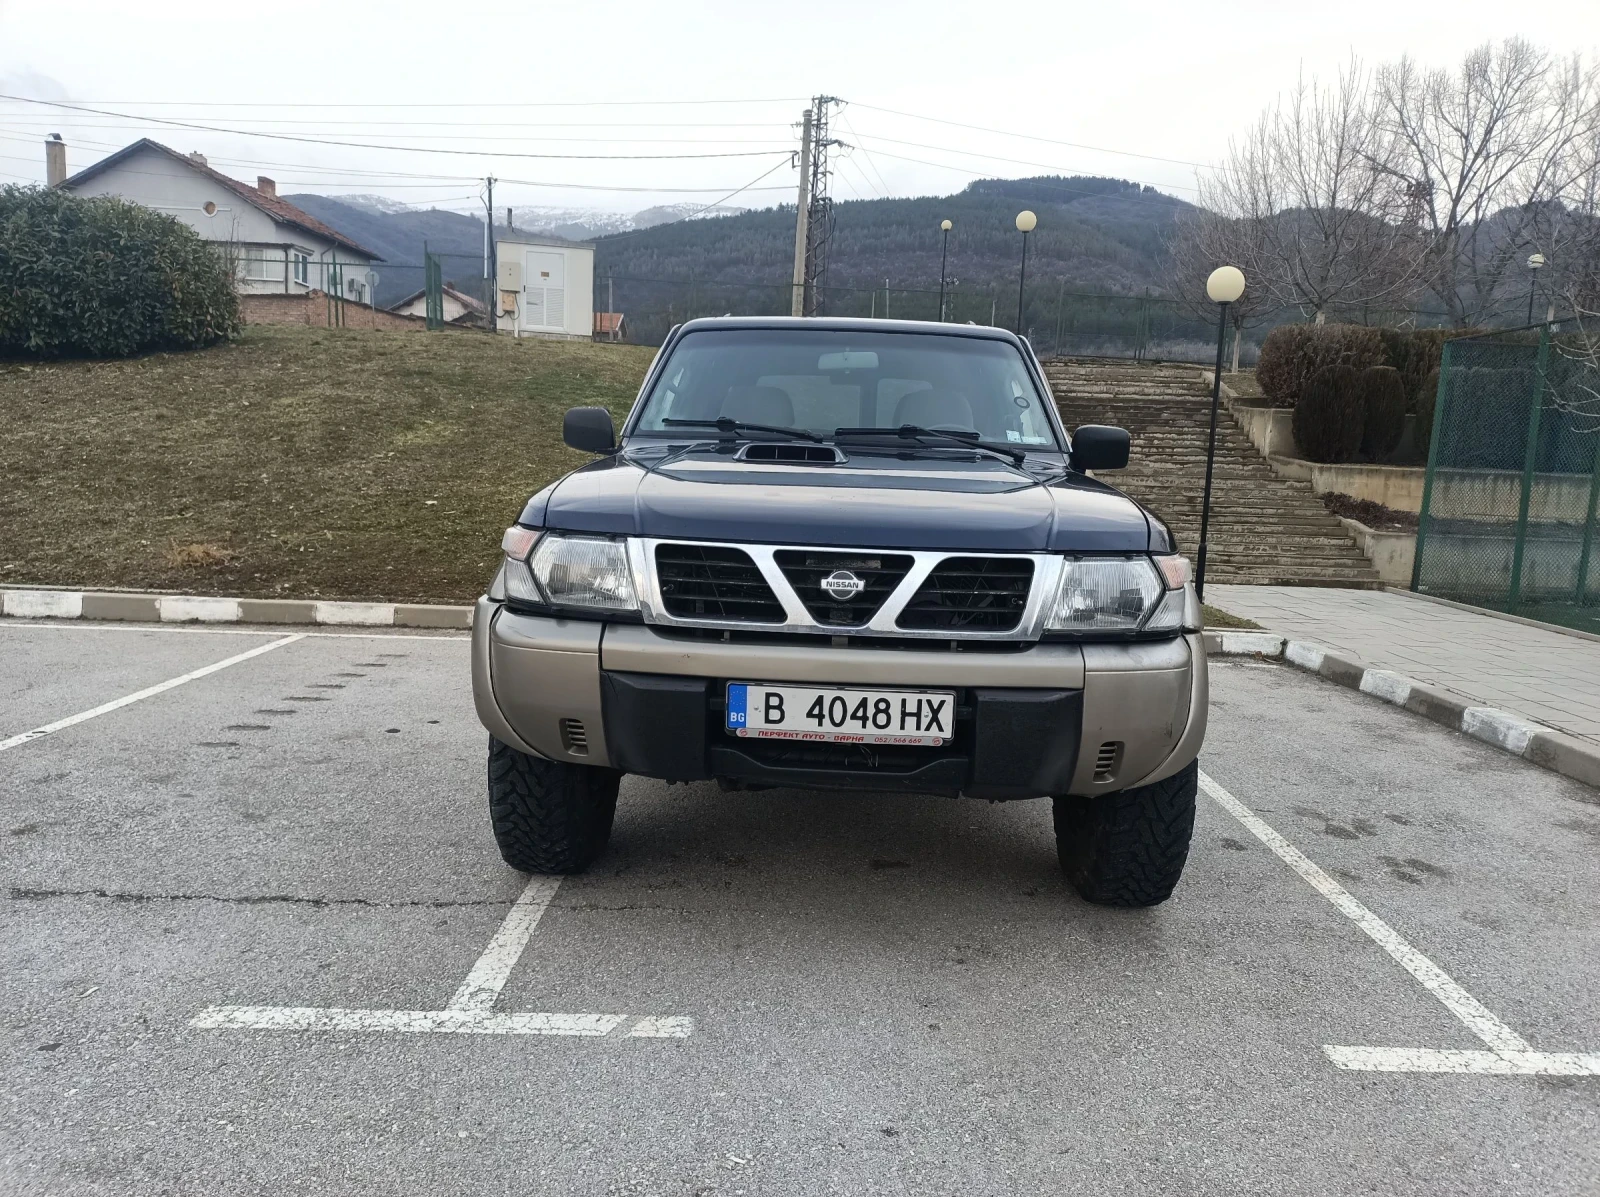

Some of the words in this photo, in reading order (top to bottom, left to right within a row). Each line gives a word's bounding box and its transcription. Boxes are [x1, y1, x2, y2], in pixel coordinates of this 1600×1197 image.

[730, 712, 745, 722] BG
[764, 692, 785, 724] B
[806, 694, 892, 730] 4048
[900, 698, 946, 733] HX
[758, 731, 800, 739] ПЕРФЕКТ
